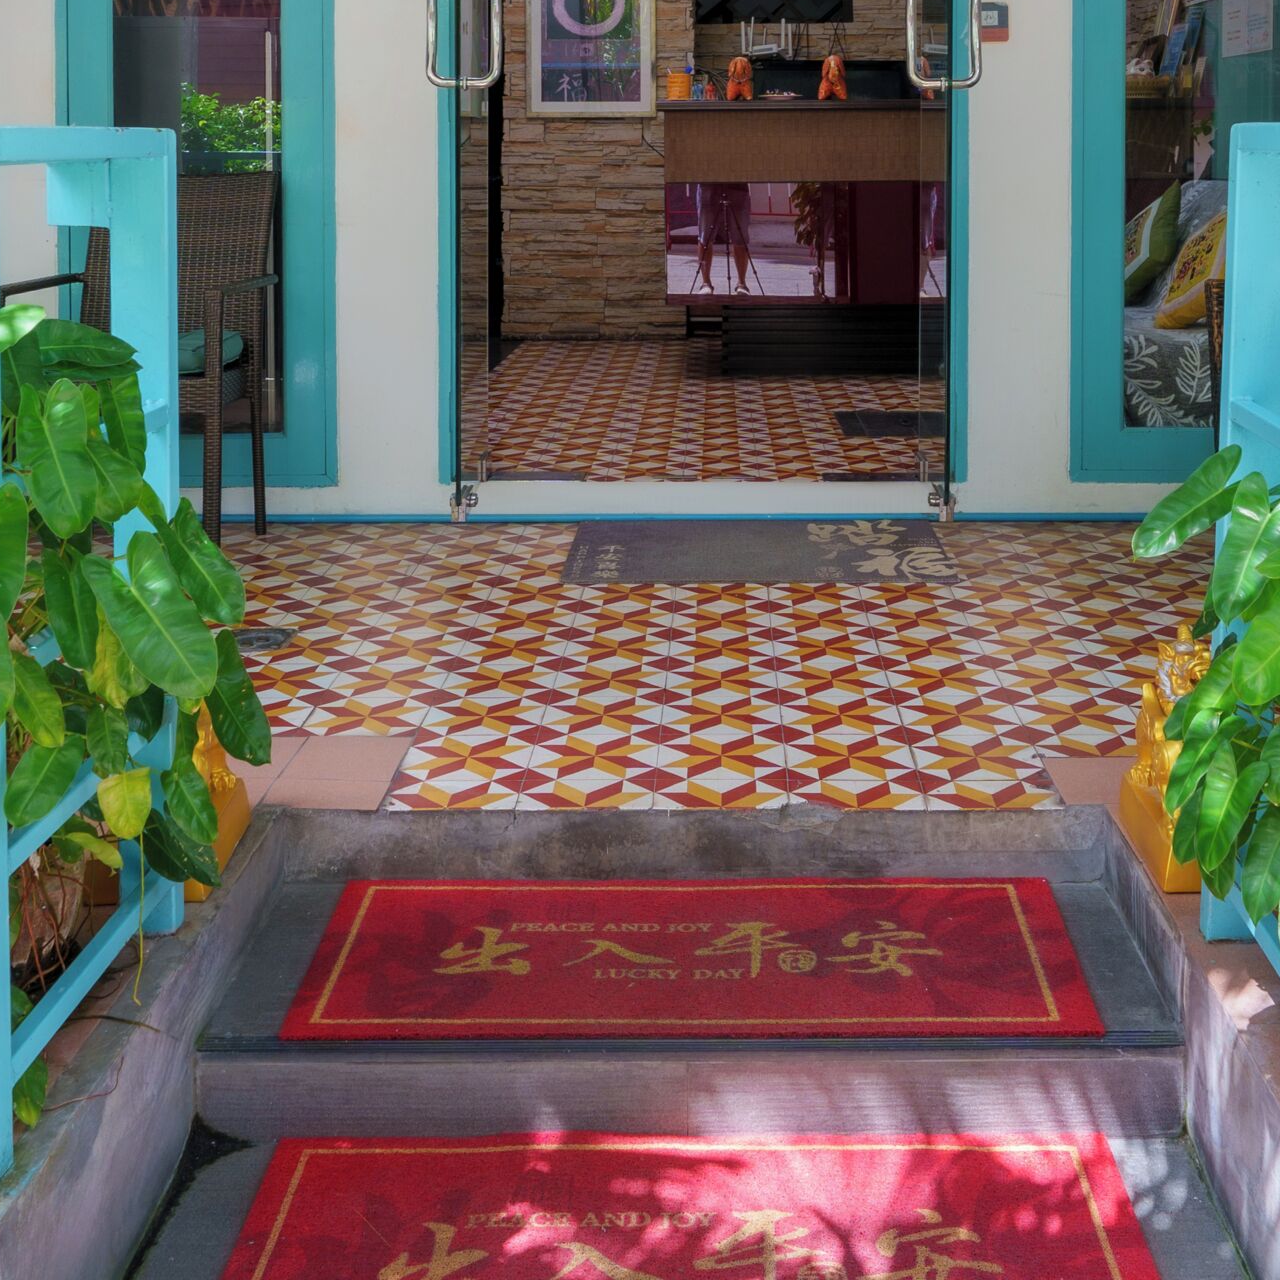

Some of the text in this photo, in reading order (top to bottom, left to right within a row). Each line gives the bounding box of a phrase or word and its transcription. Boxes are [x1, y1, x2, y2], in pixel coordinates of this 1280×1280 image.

[511, 922, 713, 933] PEACE AND JOY
[432, 920, 943, 977] 出入平安
[592, 969, 744, 980] LUCKY DAY
[464, 1211, 718, 1228] PEACE AND JOY
